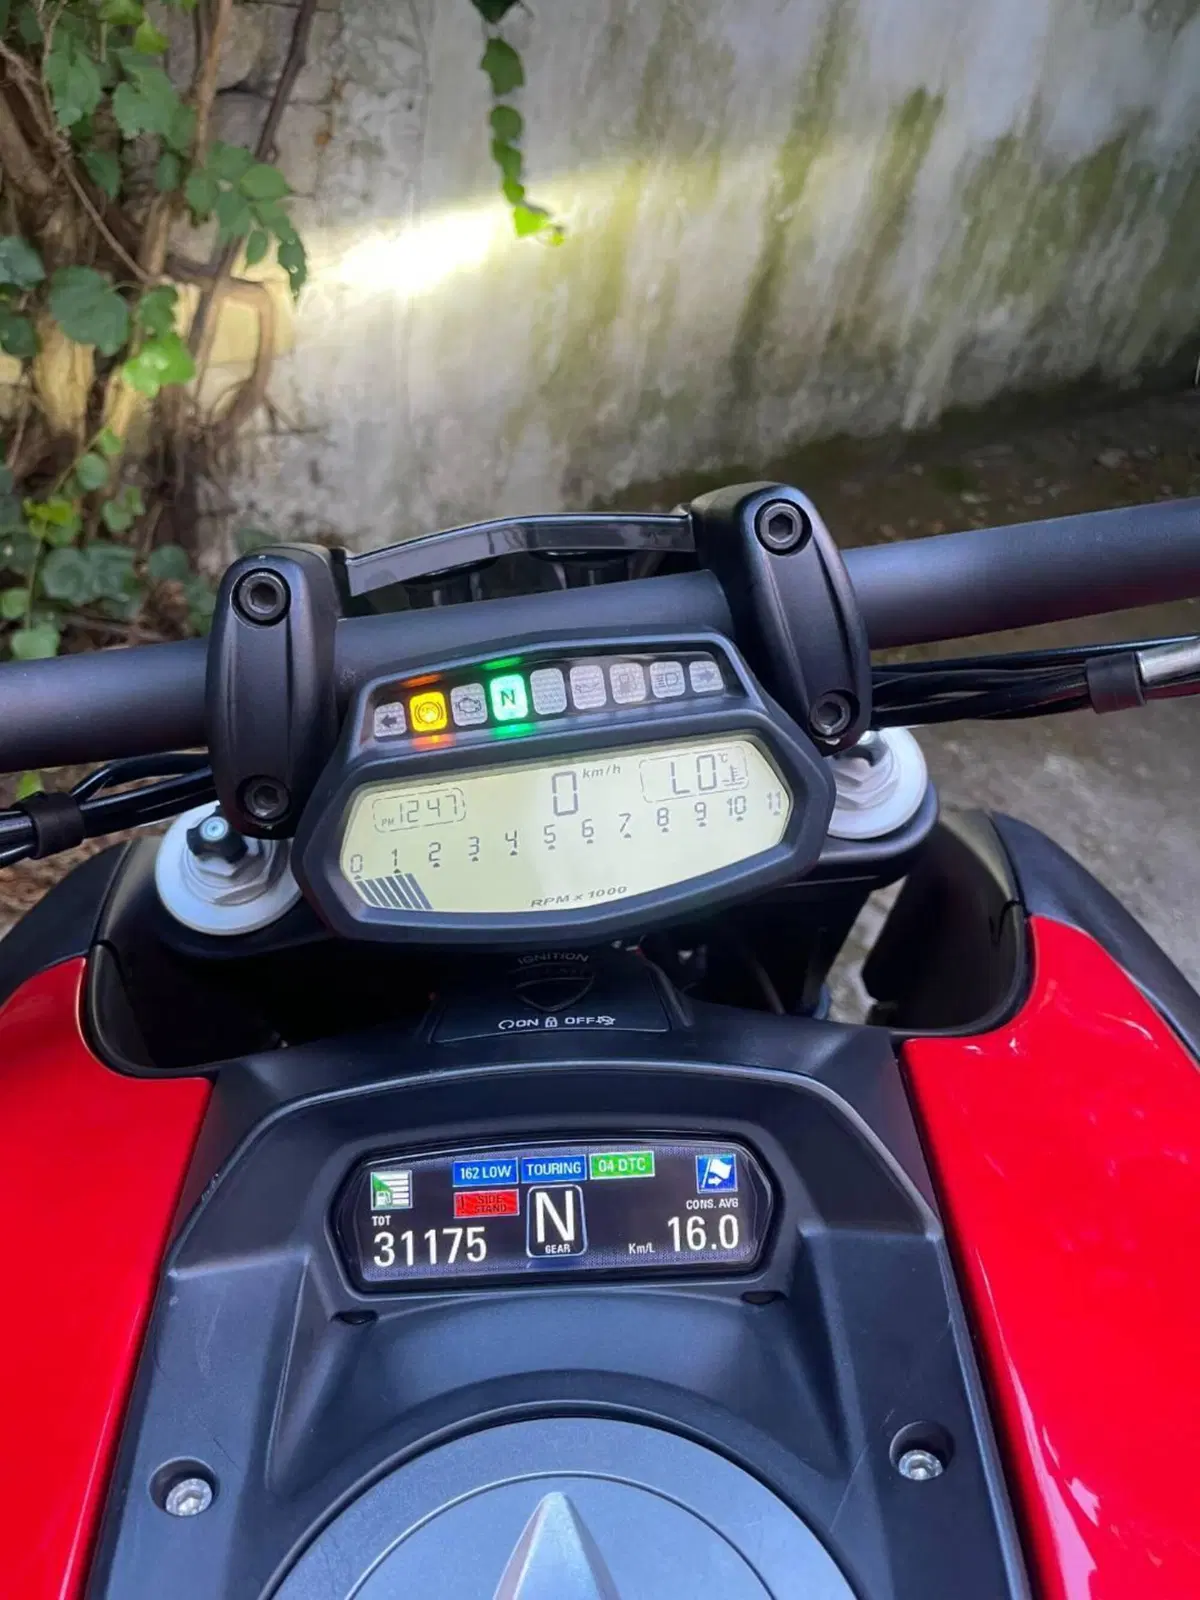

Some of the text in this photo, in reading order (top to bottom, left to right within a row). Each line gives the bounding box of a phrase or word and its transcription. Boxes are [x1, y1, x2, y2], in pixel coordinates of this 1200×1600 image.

[501, 691, 514, 707] N
[552, 764, 621, 816] 0 km/h
[381, 818, 394, 827] PM
[351, 791, 781, 873] 0 1 2 3 4 5 6 7 8 9 10 11
[531, 894, 569, 908] RPM
[588, 886, 627, 899] 1000
[517, 952, 589, 965] IGNITION
[516, 1018, 539, 1028] ON
[564, 1016, 595, 1025] OFF
[526, 1162, 581, 1176] TOURING
[598, 1157, 646, 1172] 04 DTC
[460, 1165, 512, 1180] 162 LOW
[477, 1194, 504, 1205] SIDE
[686, 1197, 739, 1210] CONS. AVG
[474, 1203, 507, 1214] STAND
[371, 1214, 391, 1227] TOT
[534, 1190, 575, 1243] N
[628, 1214, 740, 1255] Km/L 16.0
[373, 1226, 487, 1267] 31175
[544, 1243, 570, 1254] GEAR
